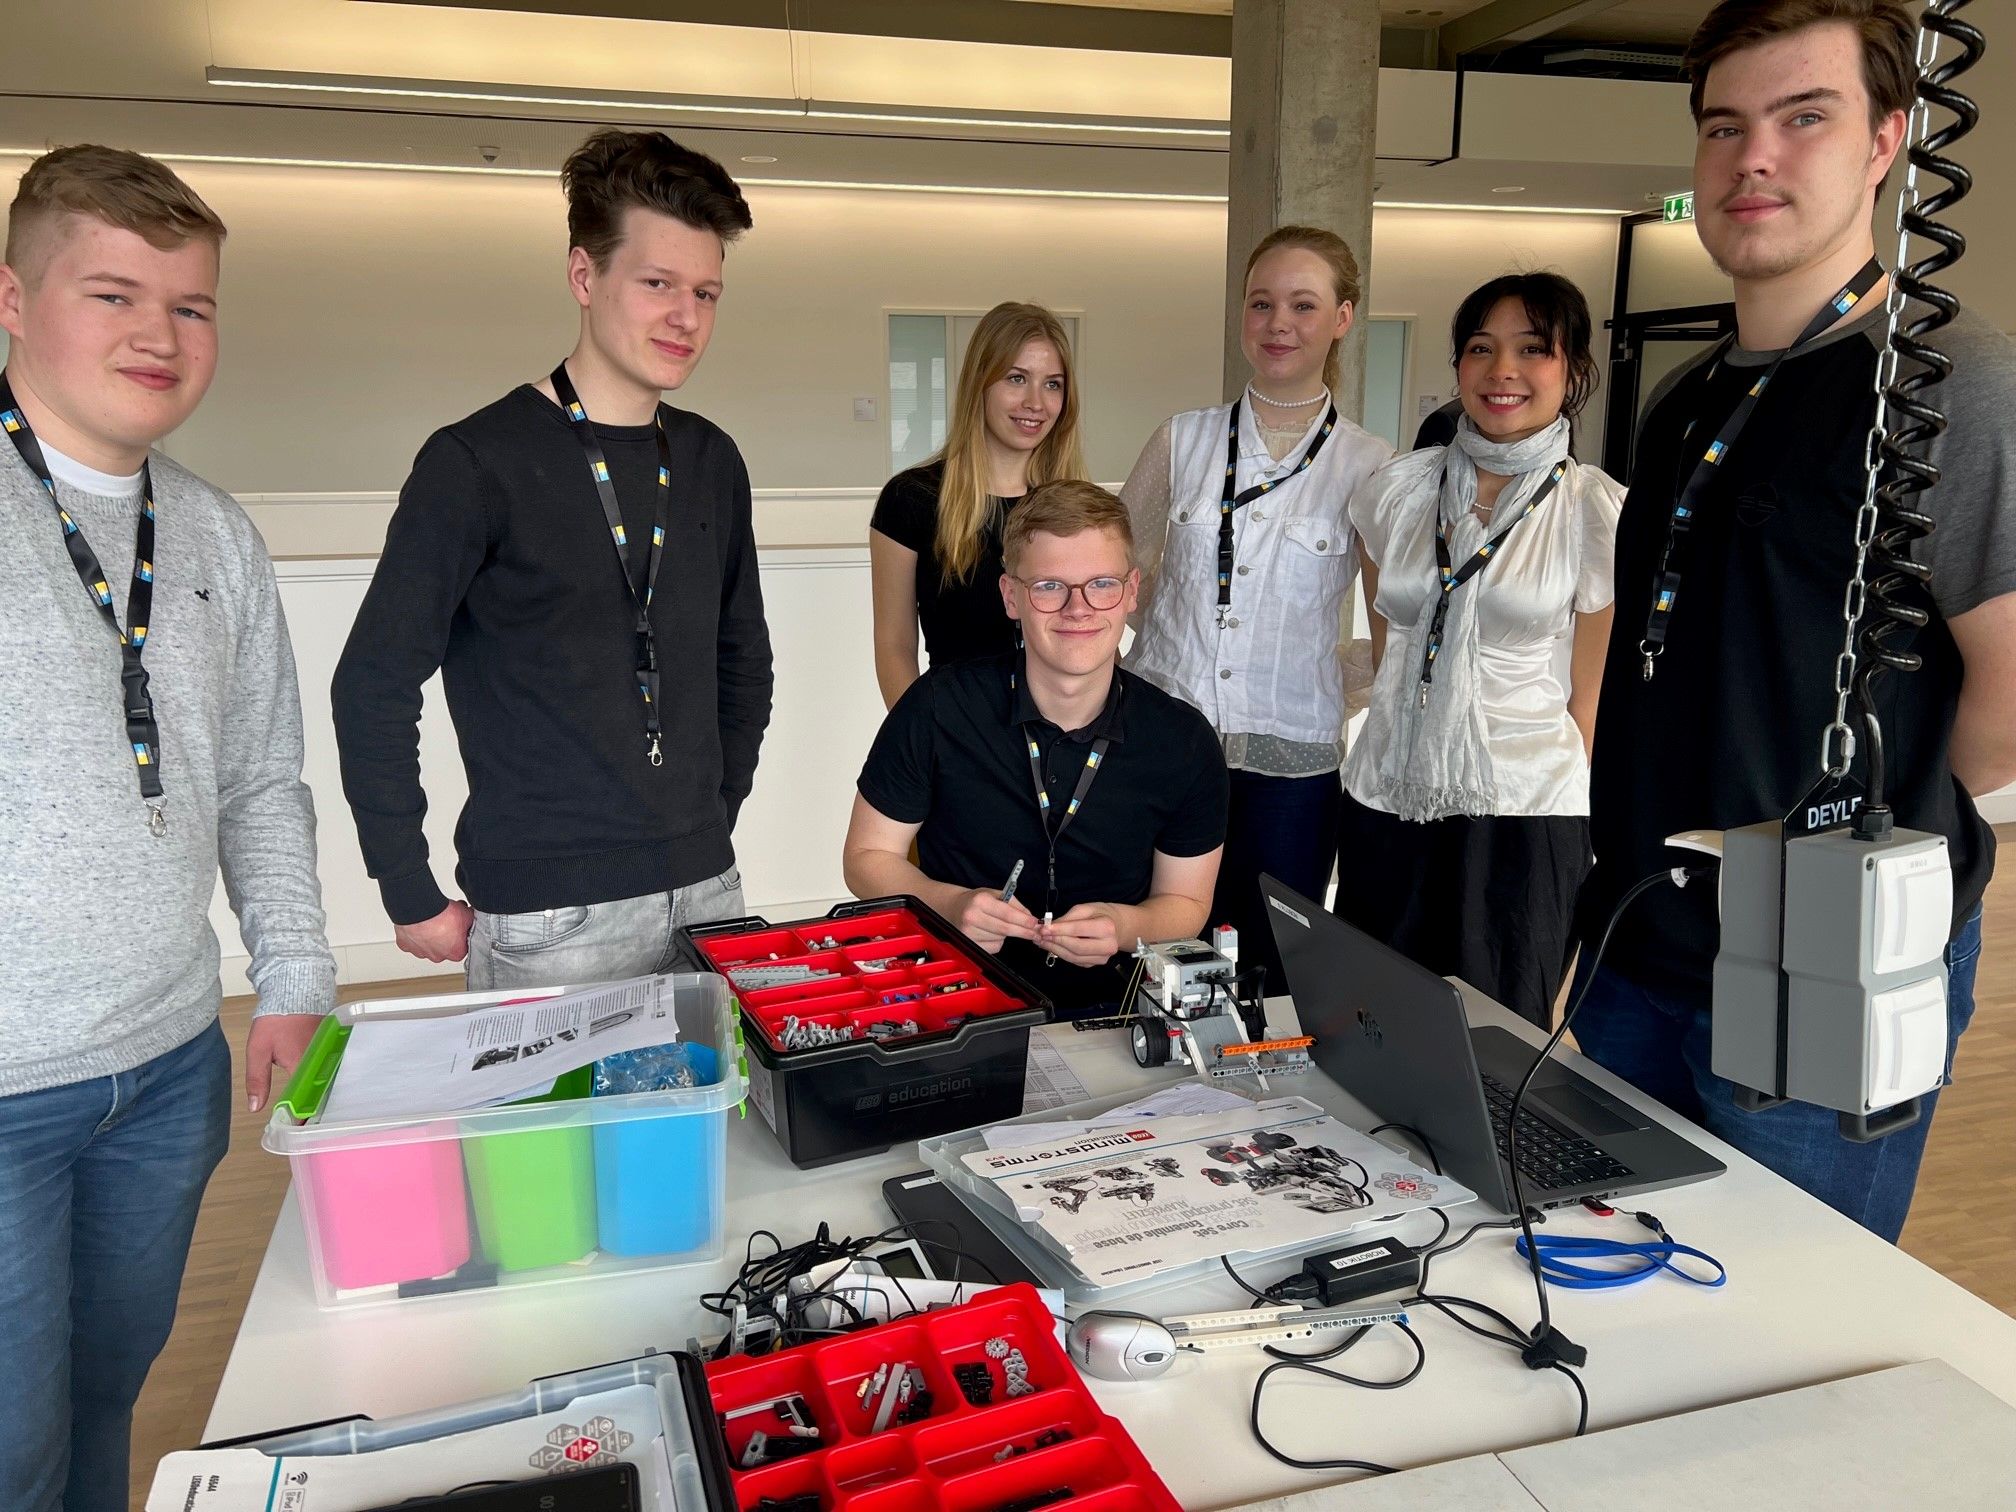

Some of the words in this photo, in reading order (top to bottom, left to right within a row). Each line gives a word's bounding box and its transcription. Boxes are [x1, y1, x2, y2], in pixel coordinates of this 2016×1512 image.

[888, 1077, 972, 1104] education
[1073, 1134, 1124, 1146] education
[1142, 1219, 1204, 1240] Ensemble
[1192, 1226, 1218, 1239] Set
[1216, 1219, 1250, 1236] Core
[1092, 1236, 1128, 1250] base
[1125, 1232, 1144, 1246] de
[1084, 1335, 1092, 1365] MEDION
